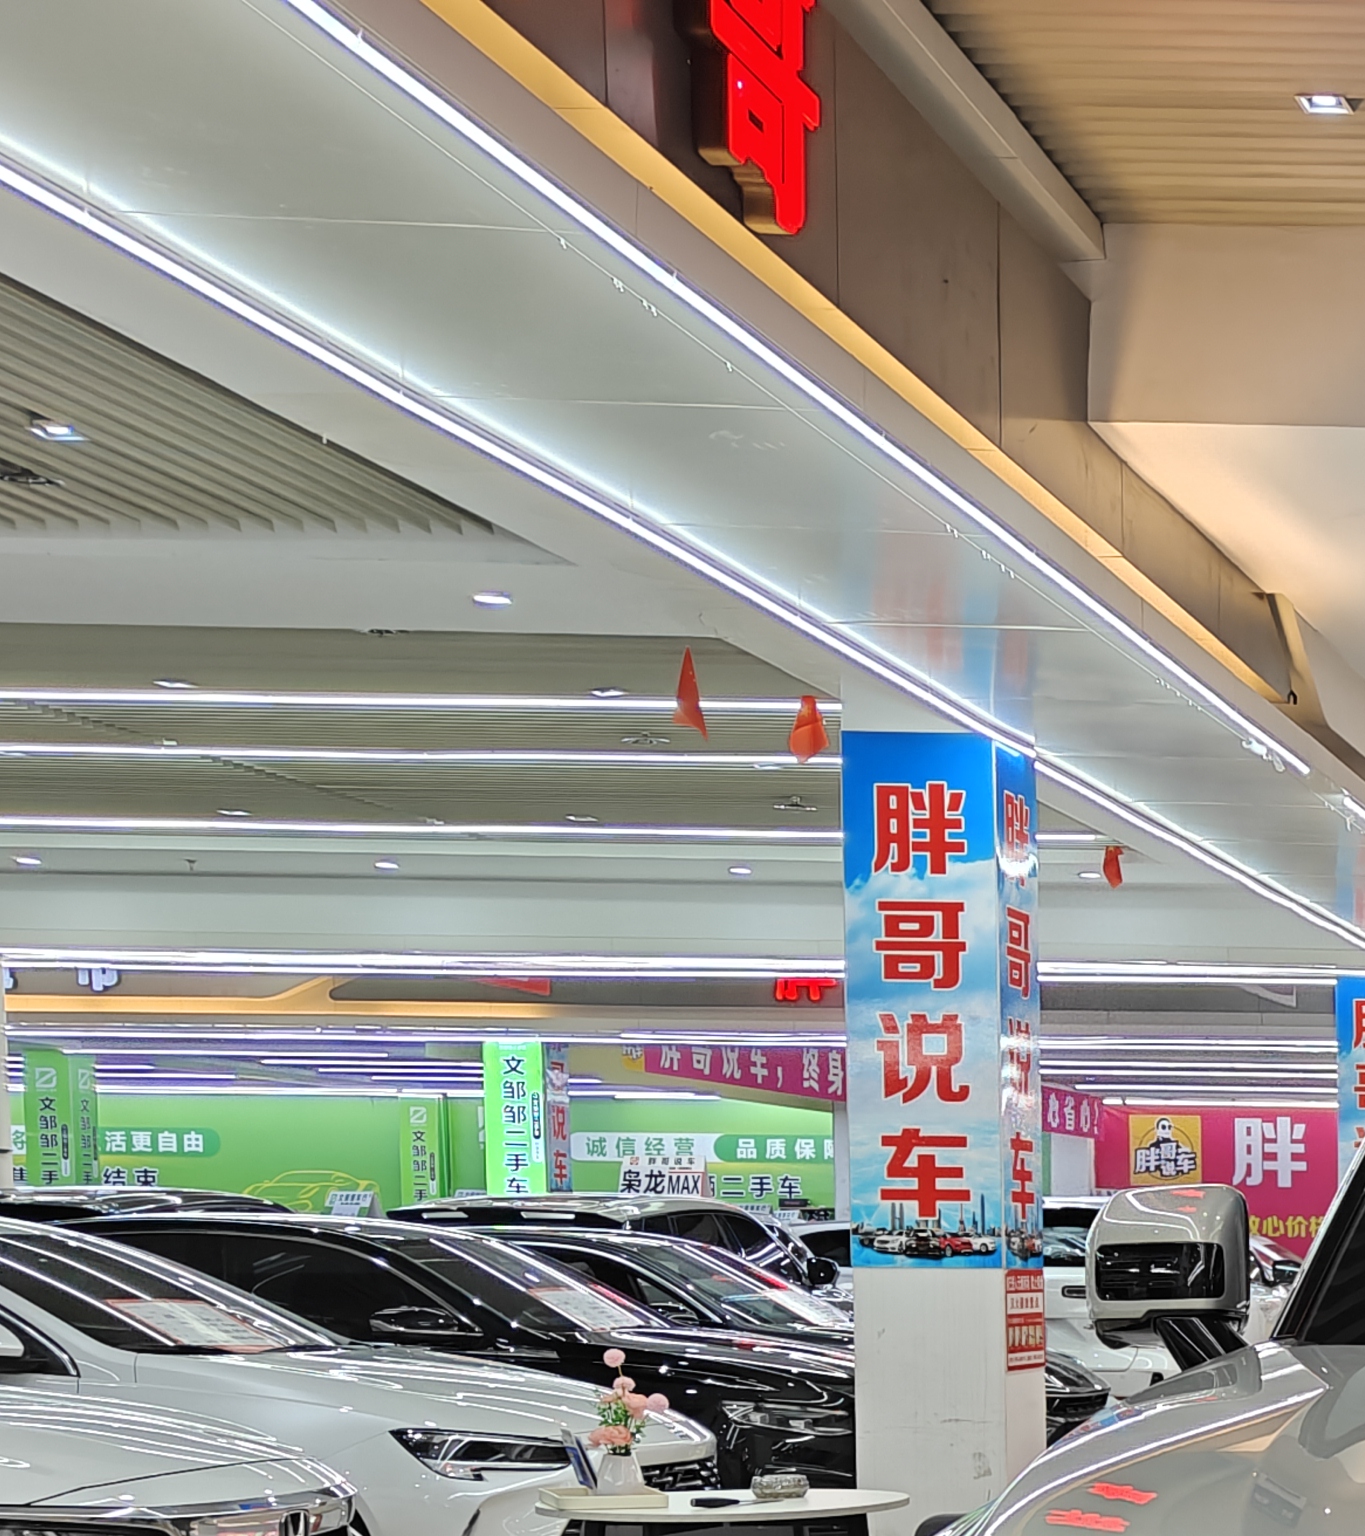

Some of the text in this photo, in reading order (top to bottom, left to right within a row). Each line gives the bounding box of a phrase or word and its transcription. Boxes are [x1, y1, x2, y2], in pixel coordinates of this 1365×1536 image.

[873, 781, 971, 1220] 胖哥说车
[104, 1130, 205, 1153] 活更自由
[585, 1136, 695, 1159] 诚信经营
[1233, 1116, 1308, 1188] 胖
[619, 1169, 702, 1195] 枭龙MAX
